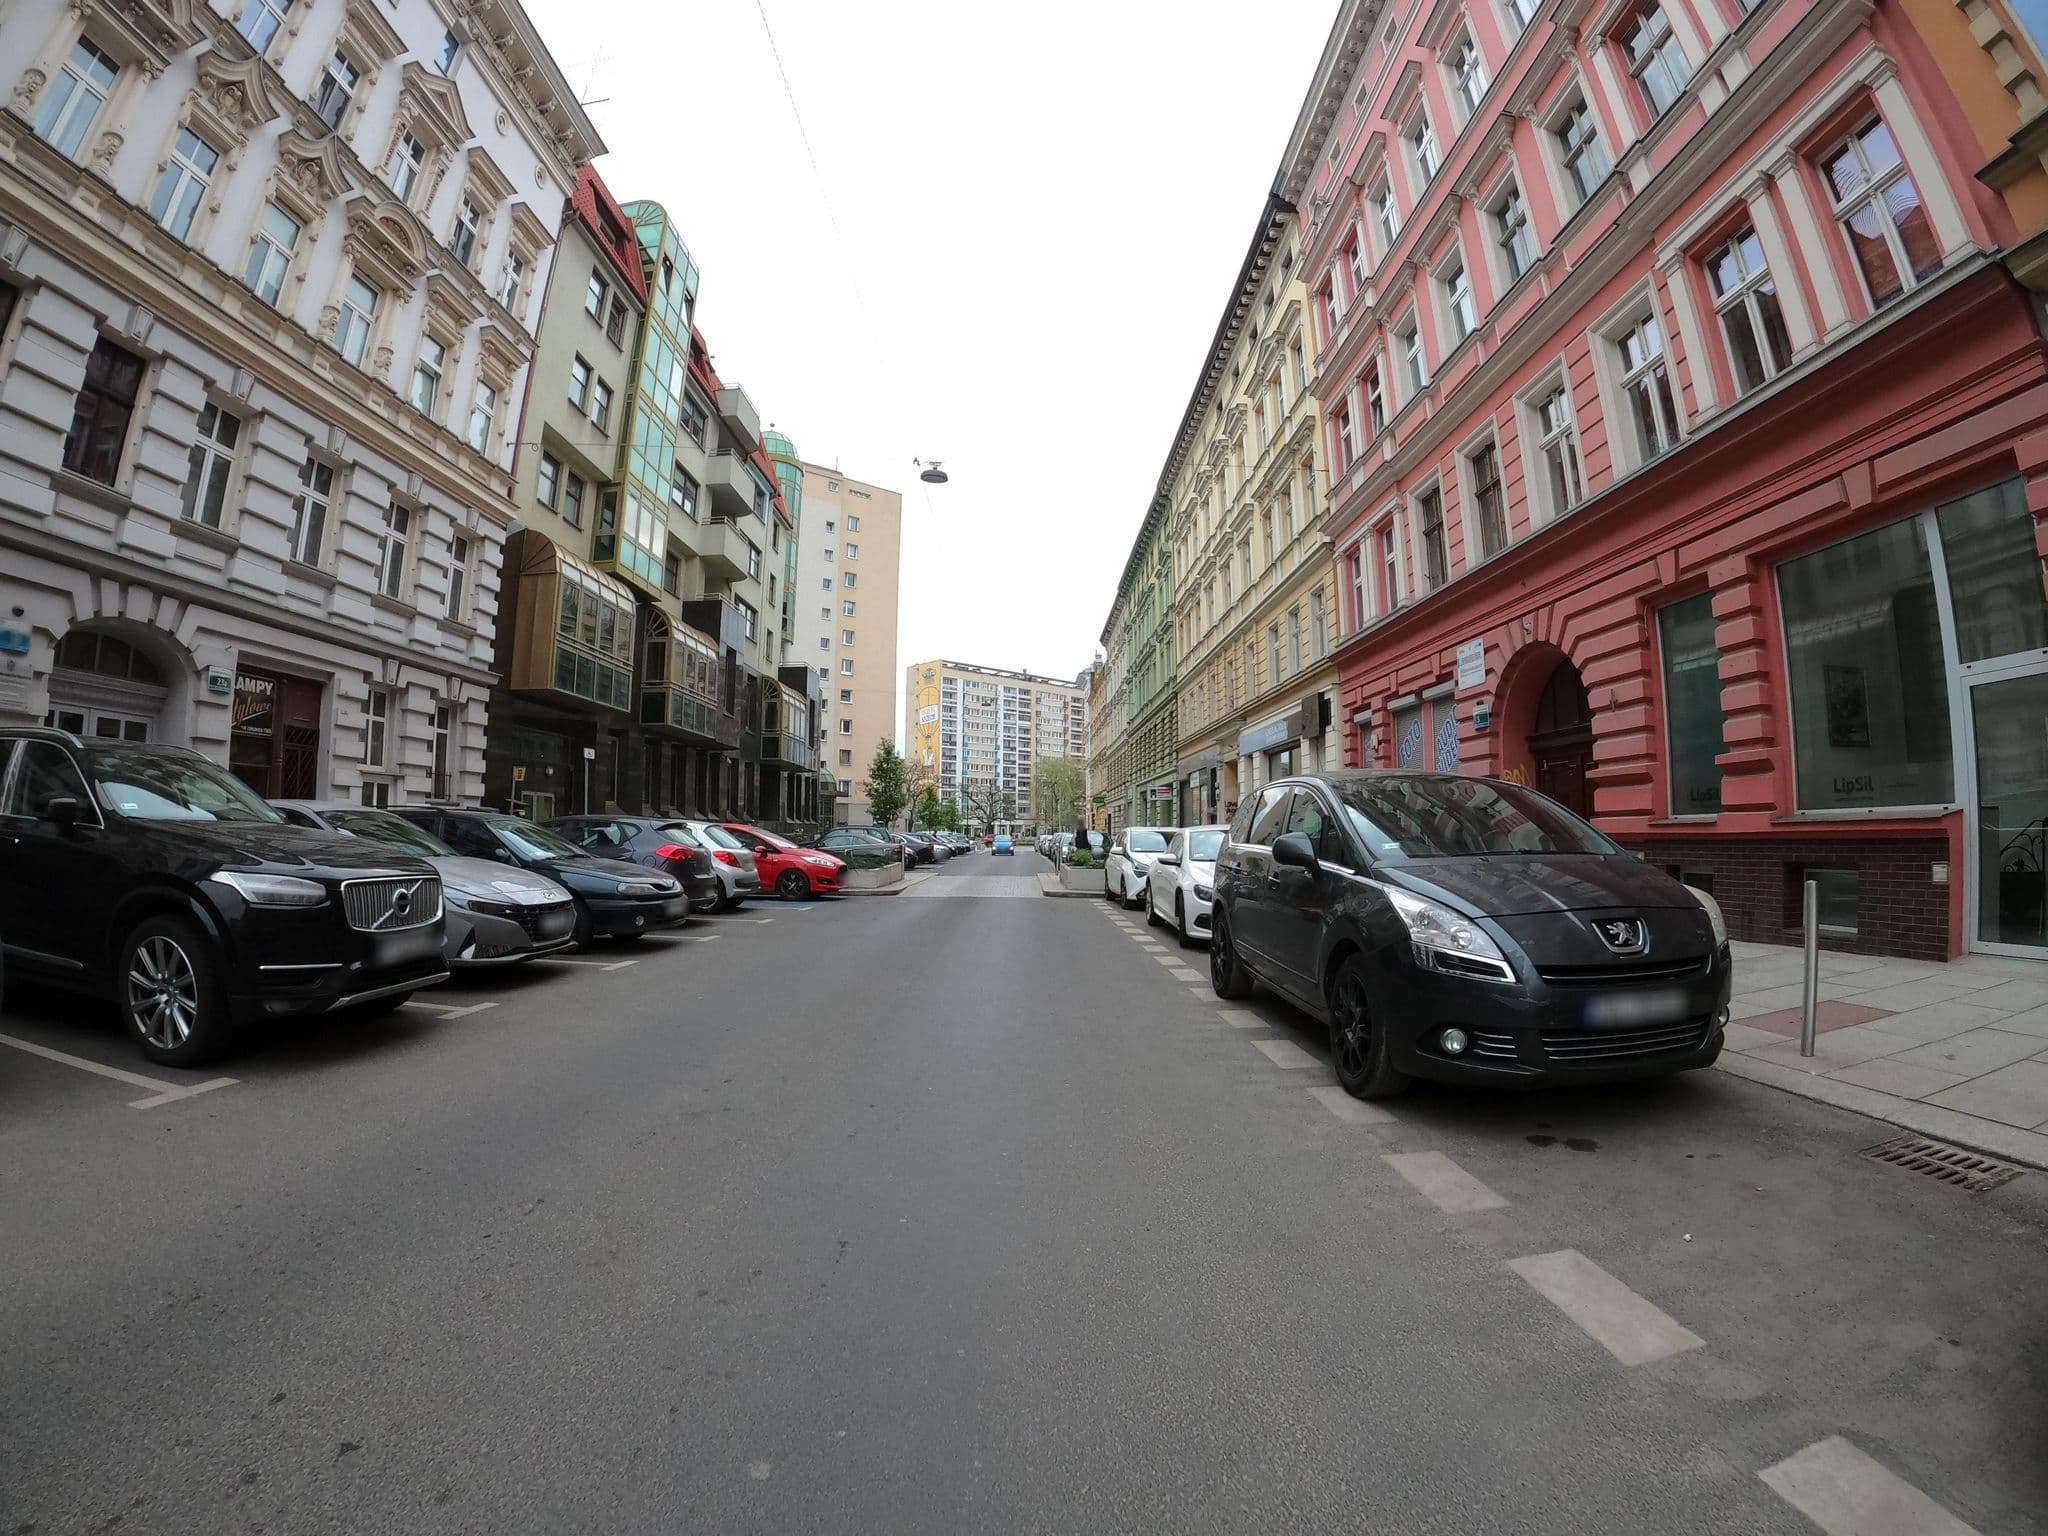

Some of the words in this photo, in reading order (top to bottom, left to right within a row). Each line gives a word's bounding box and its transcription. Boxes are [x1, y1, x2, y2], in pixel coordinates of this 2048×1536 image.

[234, 676, 274, 696] AMPY
[1400, 719, 1421, 766] FOTO
[1832, 776, 1874, 795] LipSil
